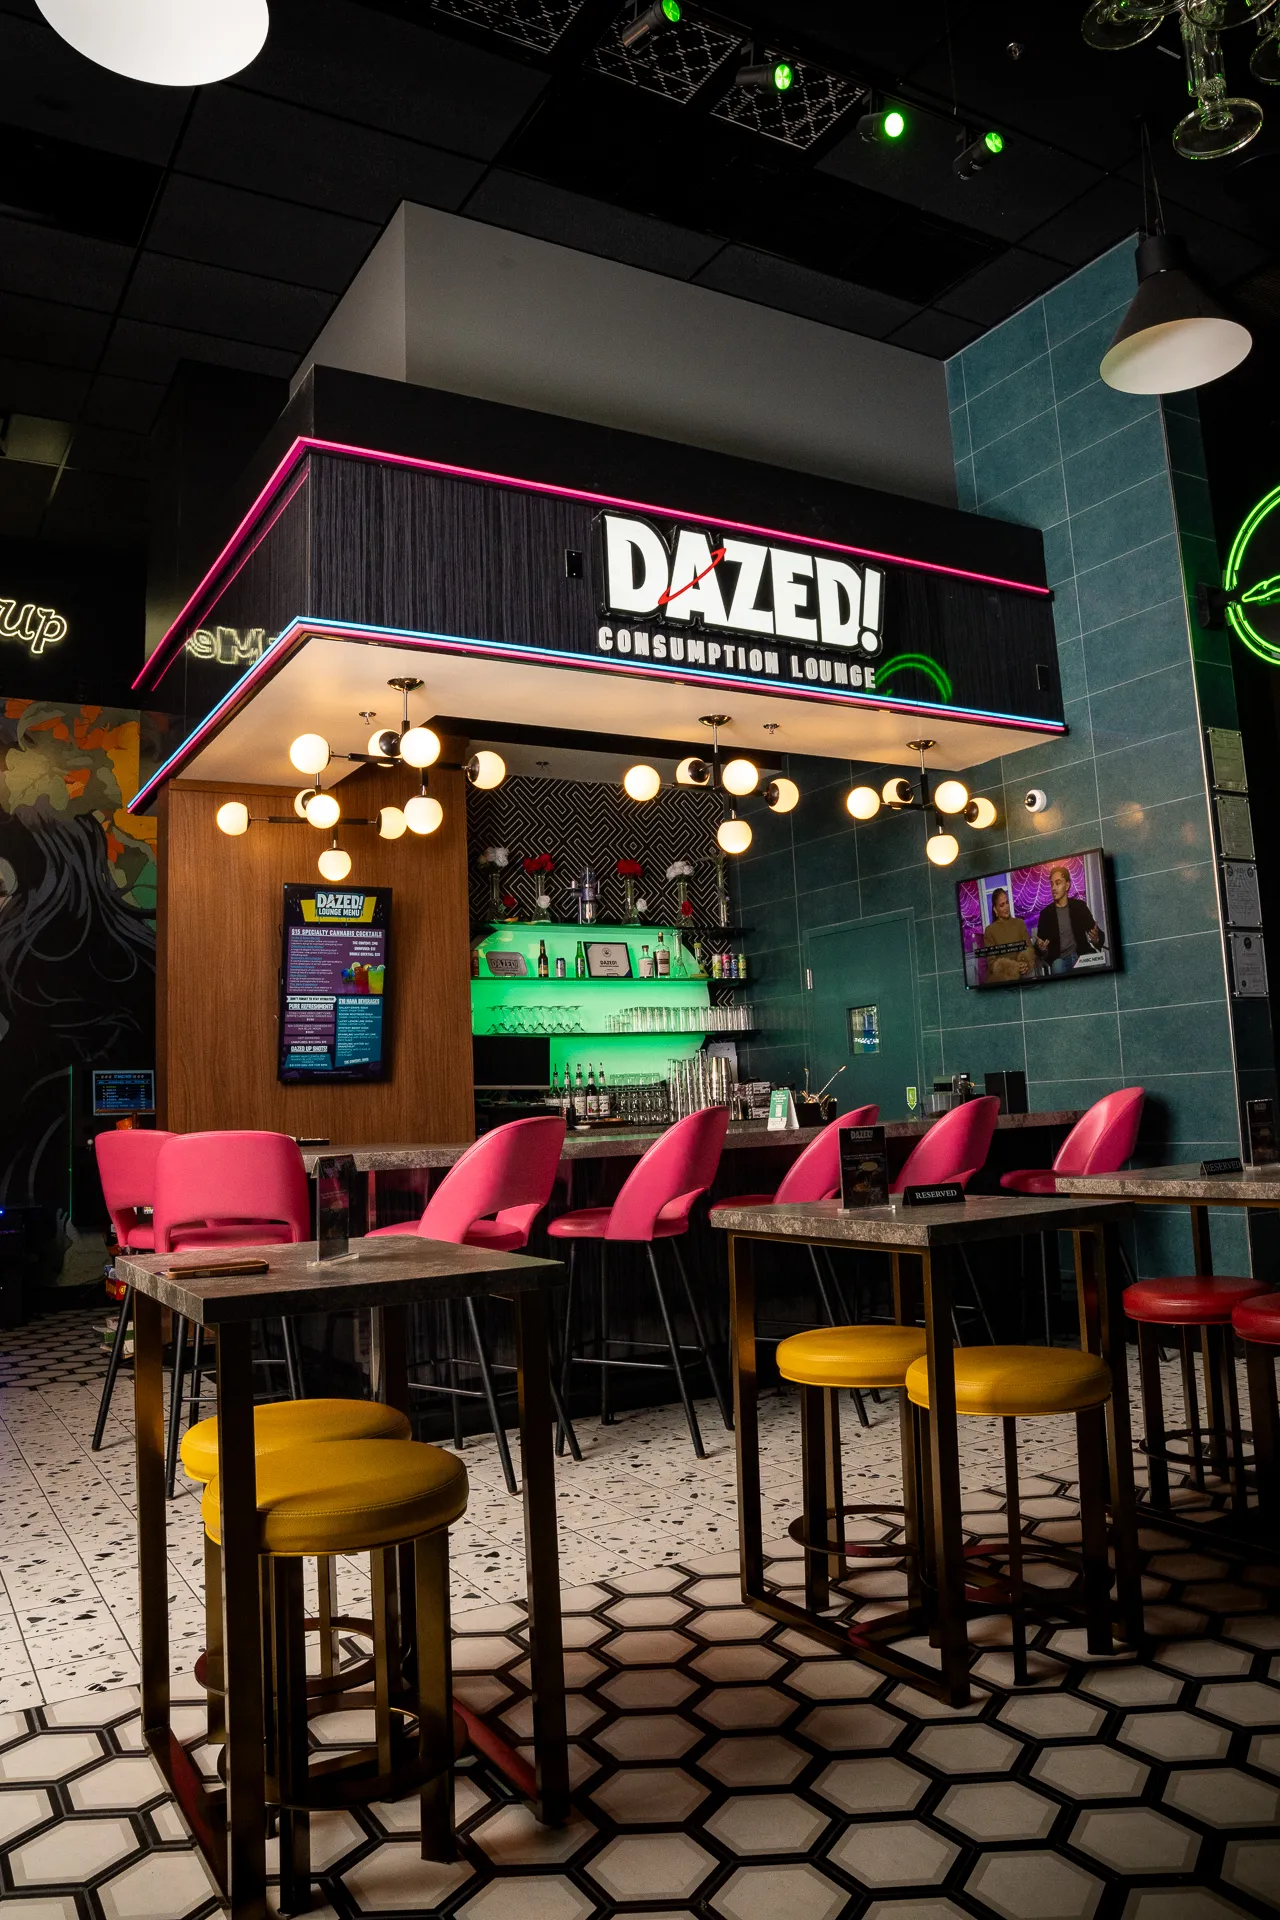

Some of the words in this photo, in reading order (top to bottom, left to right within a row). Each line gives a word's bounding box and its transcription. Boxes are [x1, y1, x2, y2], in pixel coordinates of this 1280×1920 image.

[604, 514, 881, 653] DAZED!
[598, 626, 780, 675] CONSUMPTION
[791, 655, 876, 689] LOUNGE
[317, 893, 364, 910] DAZED!
[318, 908, 342, 917] LOUNGE
[343, 909, 360, 917] MENU
[1205, 1160, 1241, 1172] RESERVED
[915, 1189, 958, 1200] RESERVED
